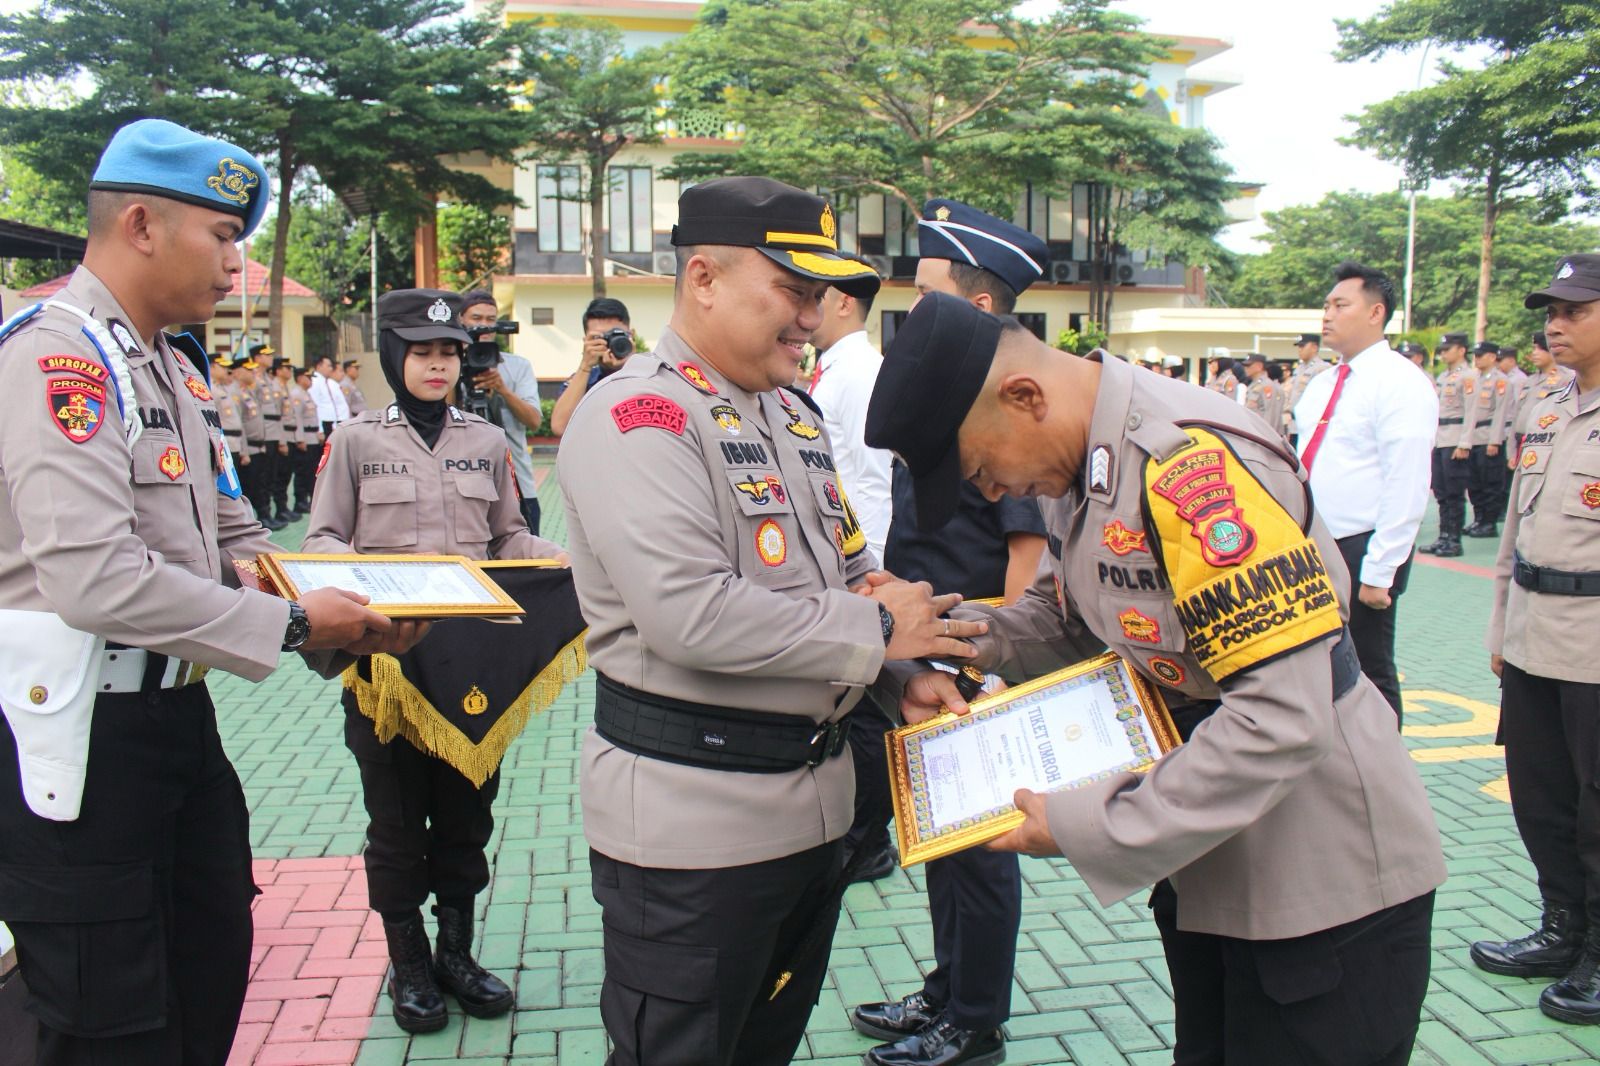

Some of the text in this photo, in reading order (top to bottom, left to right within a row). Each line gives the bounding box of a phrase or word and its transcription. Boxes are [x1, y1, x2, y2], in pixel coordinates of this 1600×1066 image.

[48, 358, 102, 377] SIPROPAM
[53, 380, 102, 395] PROPAM
[618, 399, 681, 416] PELOPOR
[620, 412, 680, 430] GEGANA
[720, 440, 768, 465] IBNU
[363, 463, 409, 476] BELLA
[445, 459, 491, 472] POLRI
[1159, 453, 1218, 488] POLRES
[1098, 562, 1167, 591] POLRI
[1283, 579, 1328, 606] LAMA
[1220, 606, 1299, 650] PONDOK
[1304, 591, 1335, 614] AREN
[1028, 706, 1049, 739] TIKET
[1038, 739, 1062, 784] UMROH
